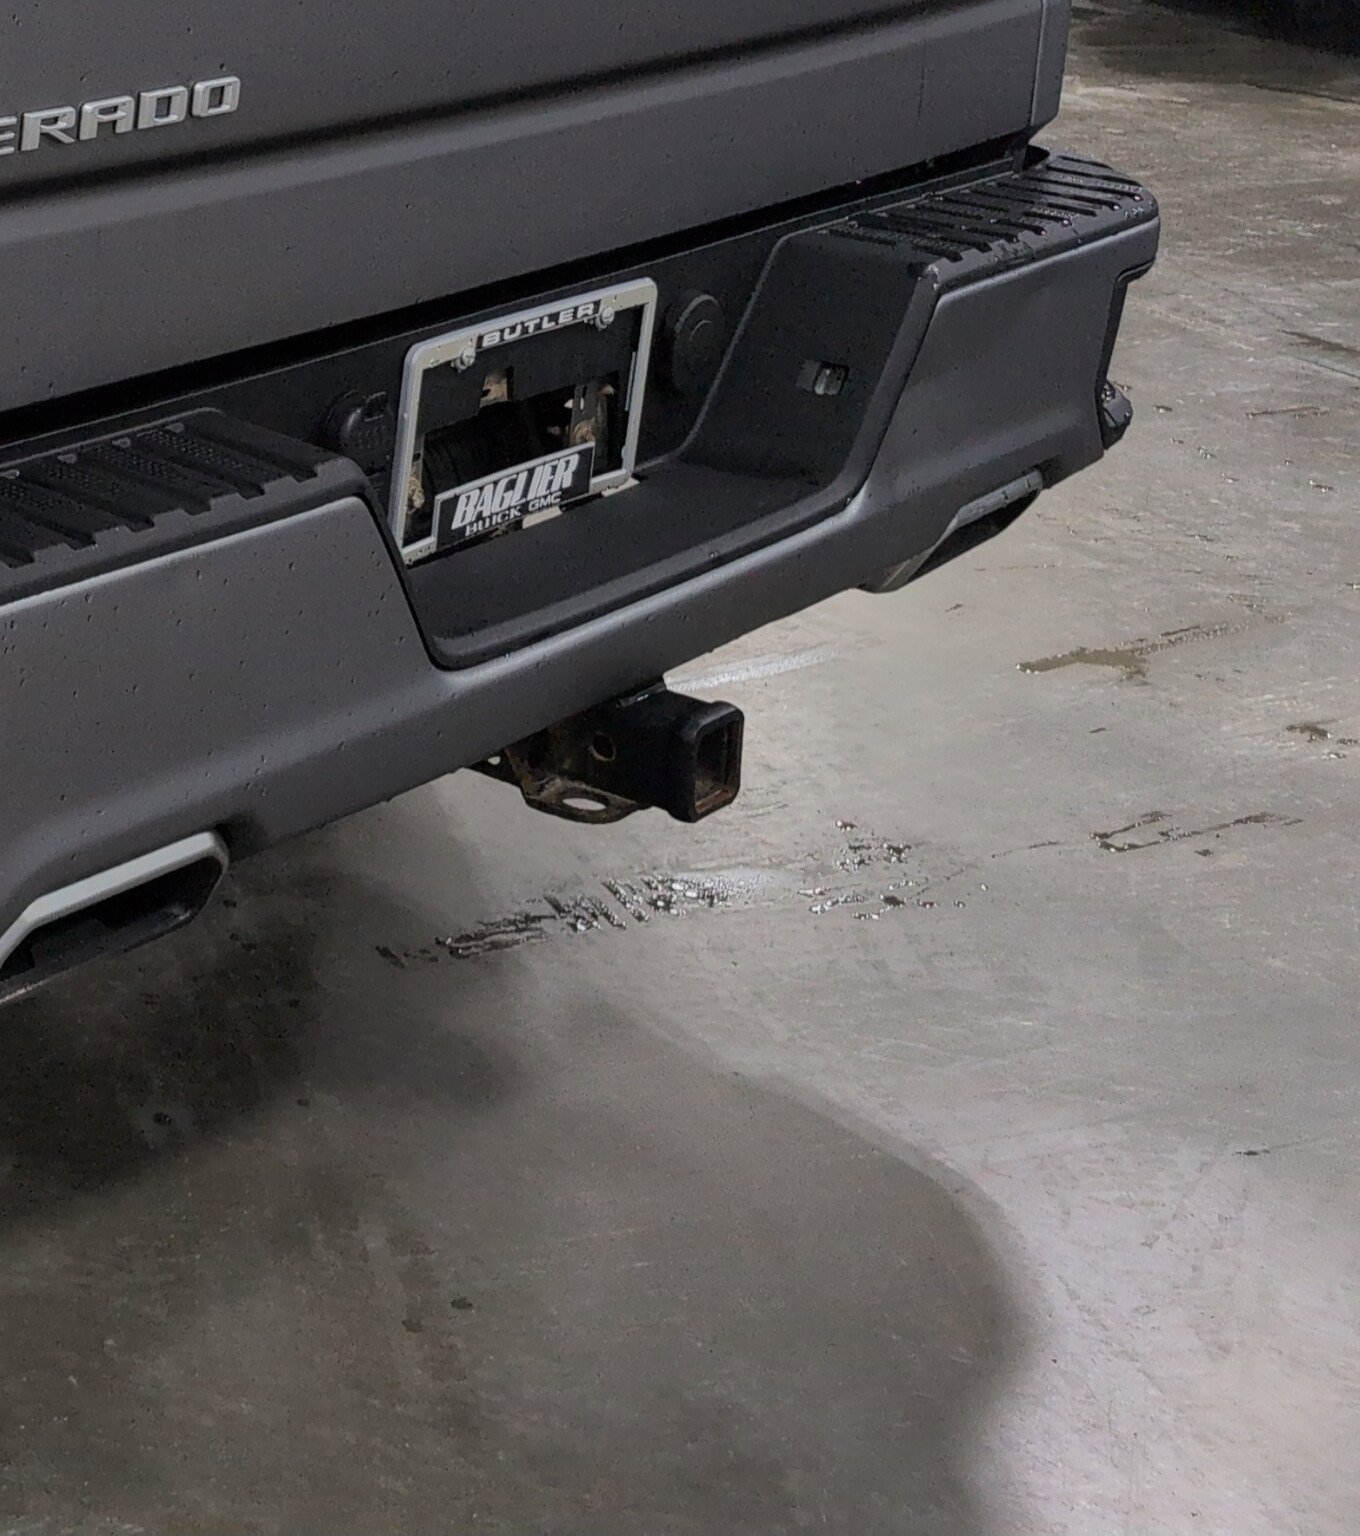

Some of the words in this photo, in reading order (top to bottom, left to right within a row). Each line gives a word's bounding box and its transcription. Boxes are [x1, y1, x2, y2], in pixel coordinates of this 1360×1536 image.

[481, 301, 594, 347] BUTLER
[451, 452, 580, 531] BAGLIER
[464, 506, 522, 537] BUICK
[528, 491, 563, 513] GMC
